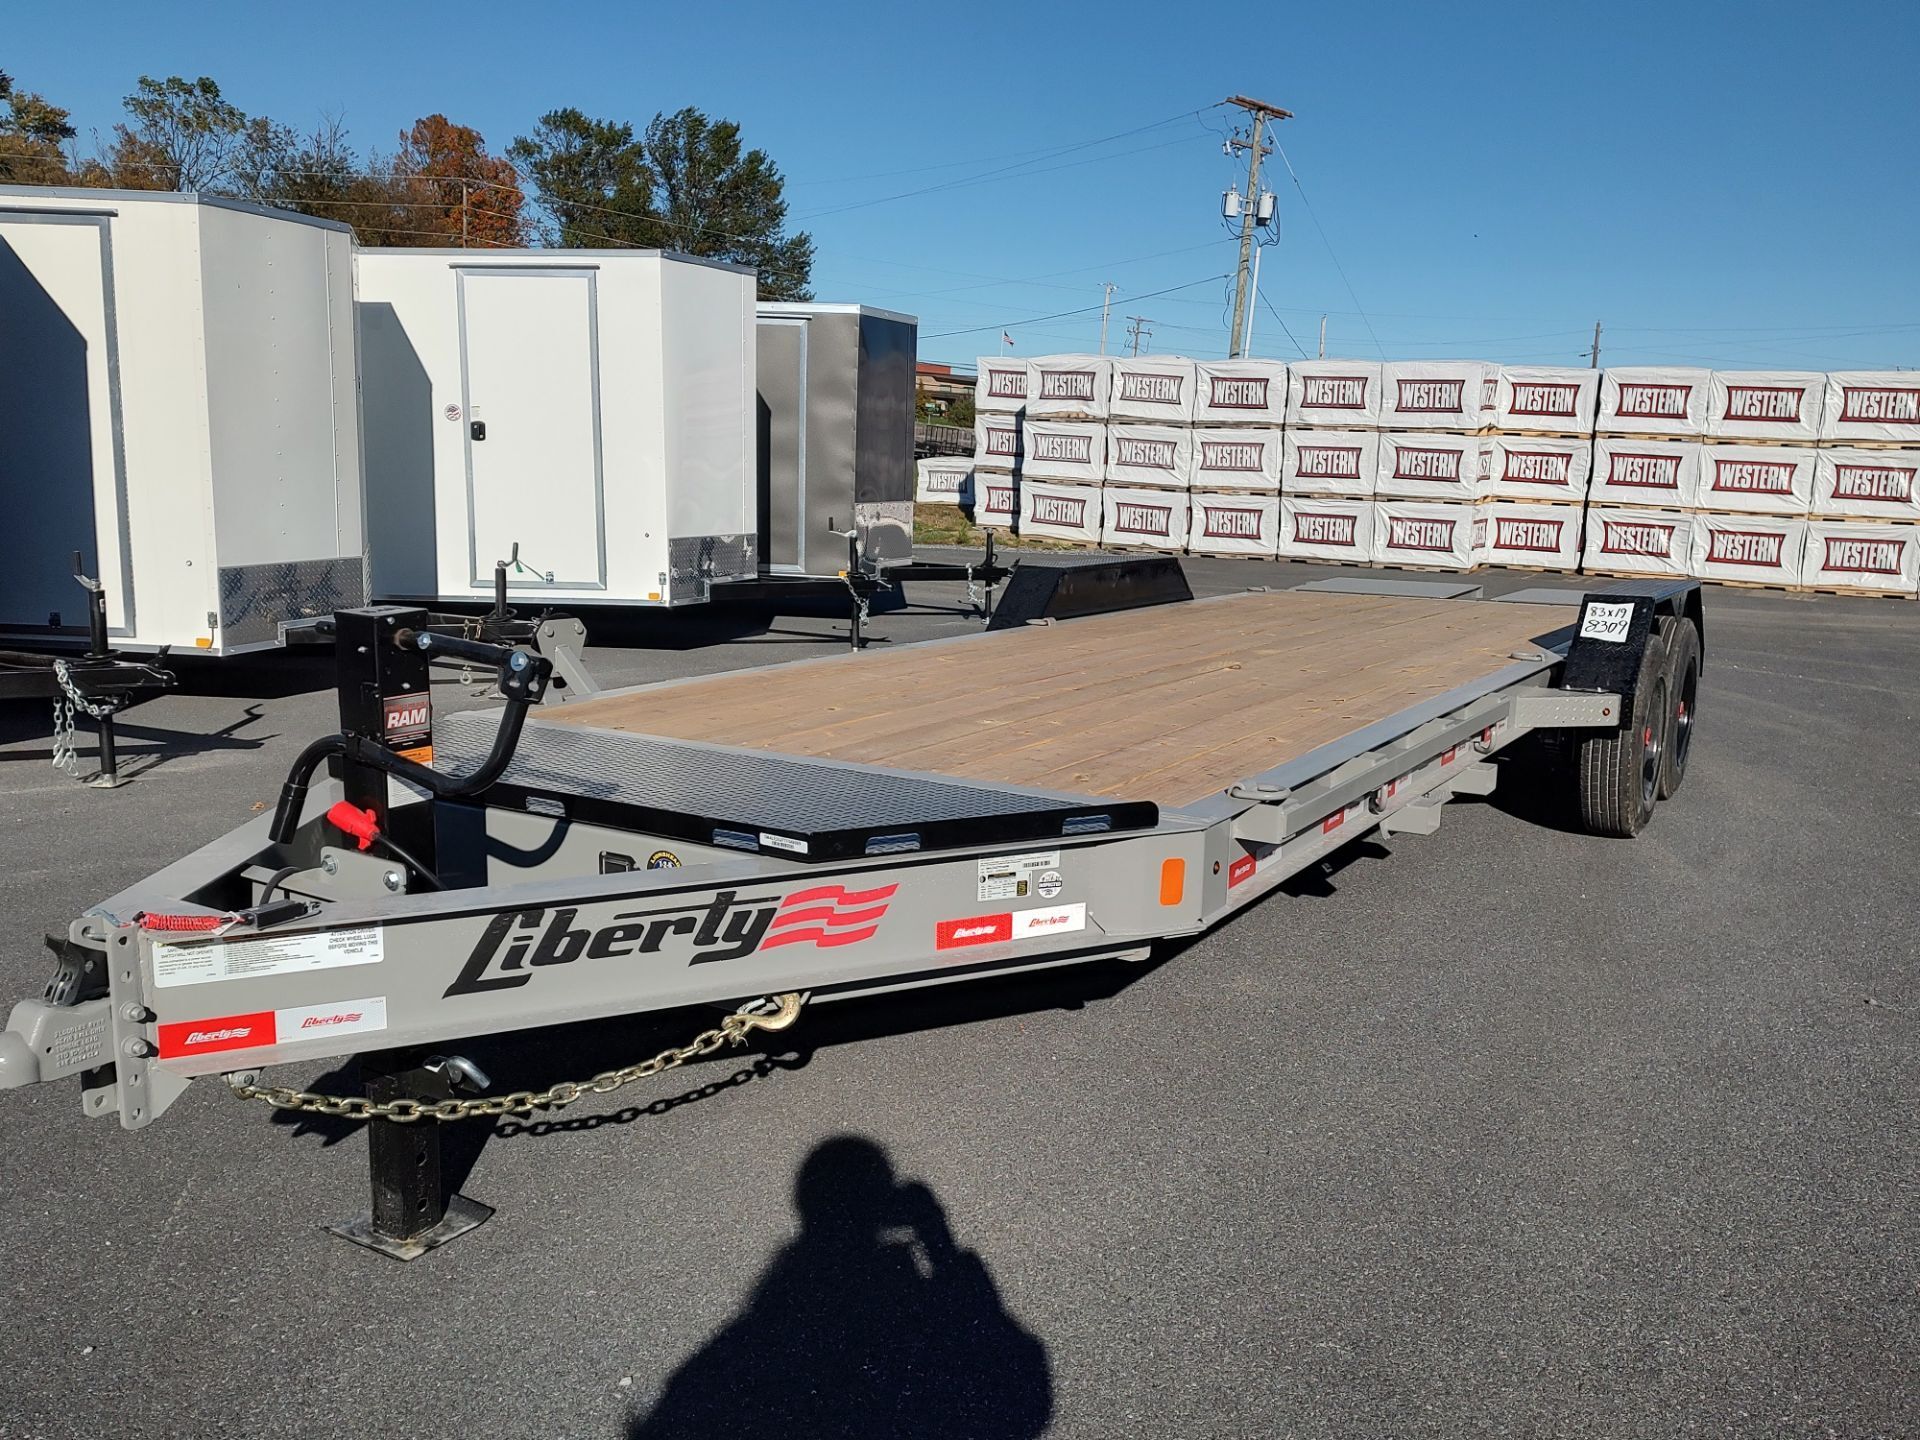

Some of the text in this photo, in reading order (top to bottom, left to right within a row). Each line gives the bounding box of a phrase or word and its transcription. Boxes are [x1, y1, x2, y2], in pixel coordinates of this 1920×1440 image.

[992, 373, 1026, 396] WESTER
[1044, 372, 1093, 397] WESTERN
[1125, 374, 1179, 400] WESTERN
[1214, 381, 1264, 405] WESTERN
[1306, 379, 1364, 405] WESTERN
[1400, 382, 1460, 409] WESTERN
[1515, 385, 1575, 413] WESTERN
[1622, 387, 1686, 415] WESTERN
[1730, 388, 1799, 418] WESTERN
[1847, 391, 1919, 420] WESTERN
[1037, 436, 1088, 461] WESTERN
[1119, 441, 1173, 467] WESTERN
[1205, 444, 1259, 468] WESTERN
[1301, 449, 1357, 475] WESTERN
[1400, 451, 1458, 480] WESTERN
[1508, 453, 1567, 482] WESTERN
[1613, 456, 1677, 485] WESTERN
[1720, 463, 1790, 491] WESTERN
[929, 472, 968, 491] WESTERN
[1839, 467, 1910, 498] WESTERN
[1035, 498, 1083, 525] WESTERN
[1119, 505, 1169, 533] WESTERN
[1208, 510, 1258, 535] WESTERN
[1299, 515, 1352, 541] WESTERN
[1392, 520, 1450, 548] WESTERN
[1499, 520, 1559, 549] WESTERN
[1607, 525, 1670, 555] WESTERN
[1713, 534, 1781, 563] WESTERN
[1829, 541, 1899, 571] WESTERN
[1585, 620, 1628, 635] 8309
[387, 708, 427, 728] RAM
[441, 891, 782, 999] Liberty
[301, 1014, 344, 1029] Liberty
[184, 1028, 234, 1045] Liberty
